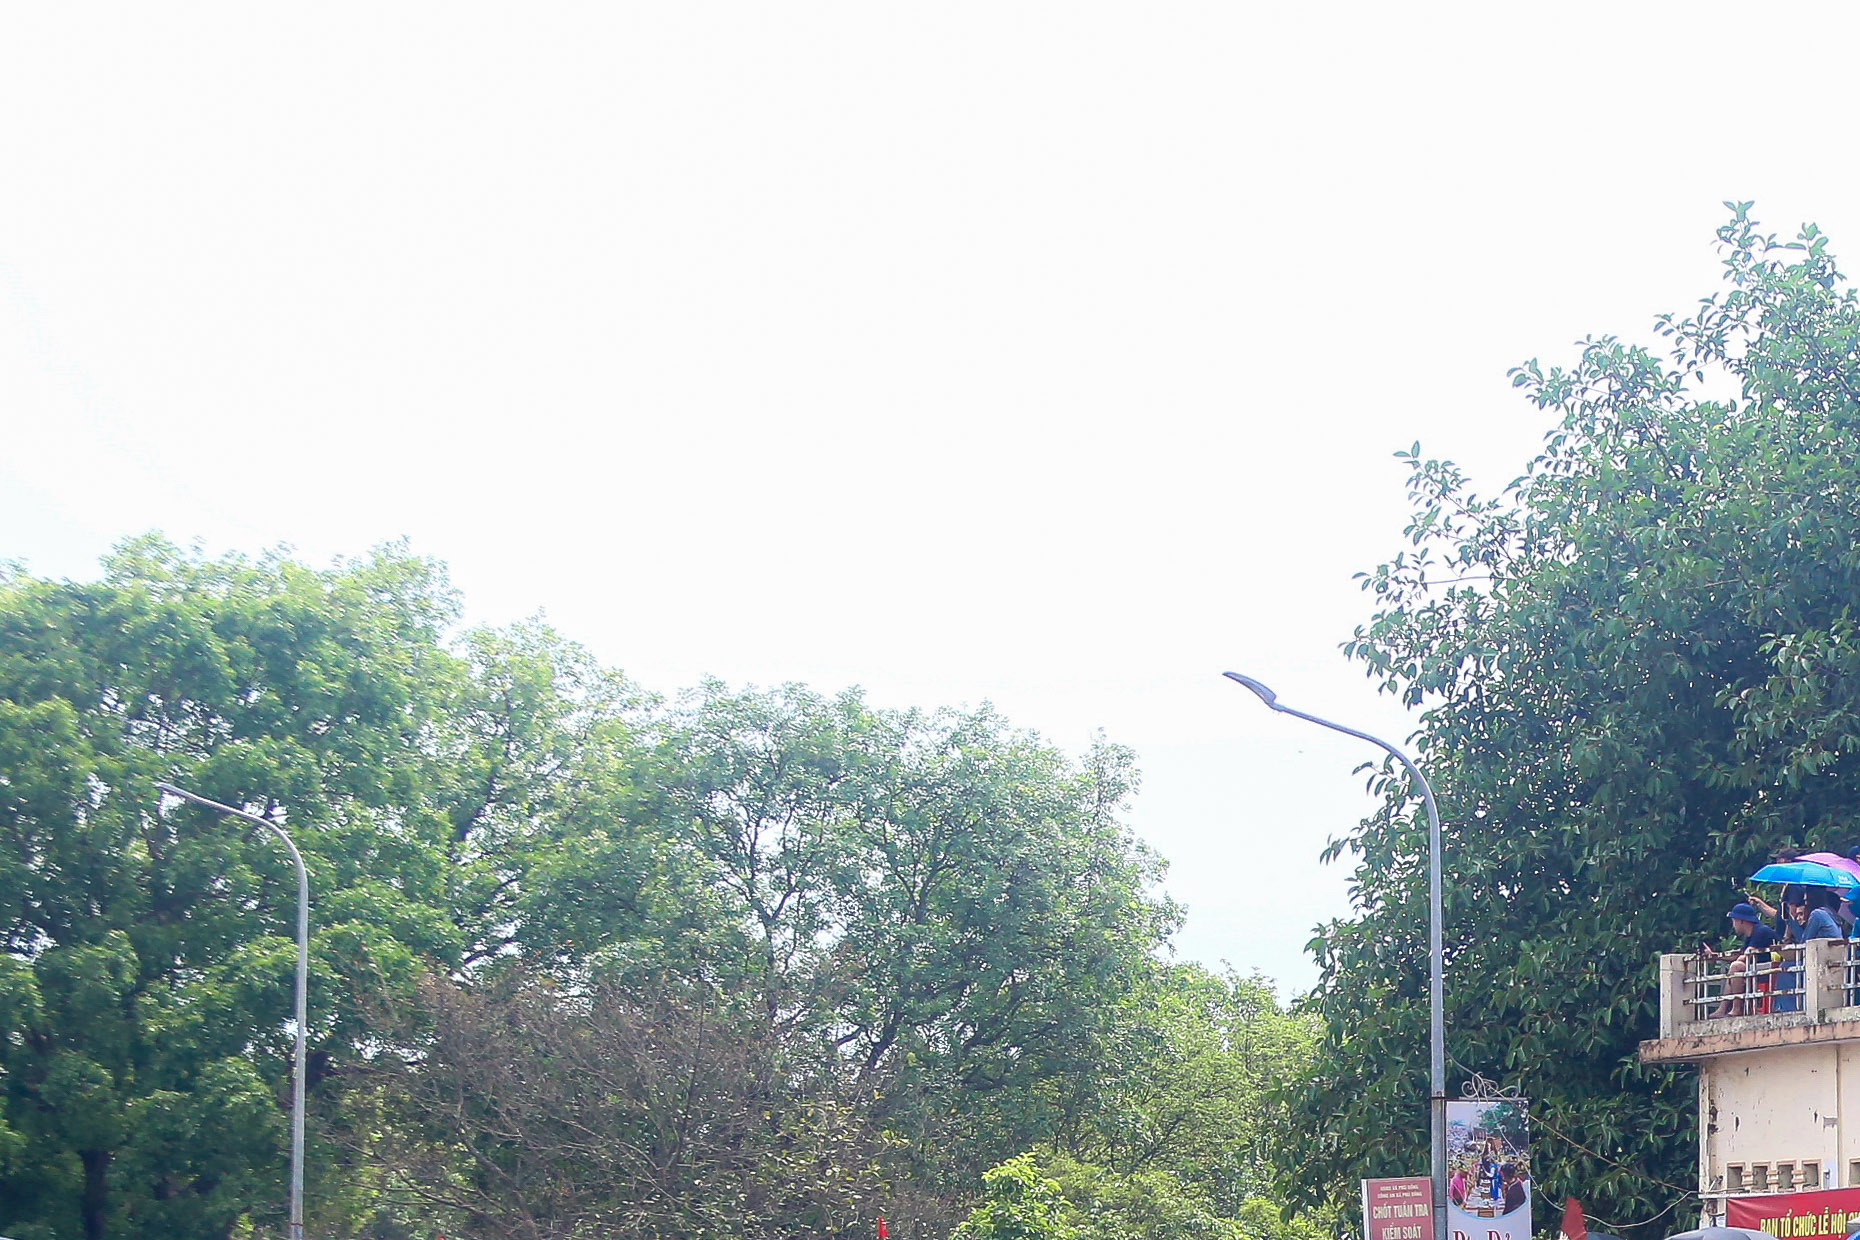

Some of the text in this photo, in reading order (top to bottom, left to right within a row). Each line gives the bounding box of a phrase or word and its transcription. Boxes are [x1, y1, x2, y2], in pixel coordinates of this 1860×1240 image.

[1373, 1201, 1392, 1219] CHỐT
[1414, 1203, 1429, 1217] TRA
[1402, 1223, 1422, 1239] SOÁT
[1760, 1219, 1778, 1237] BAN
[1780, 1208, 1792, 1238] TỔ
[1792, 1210, 1817, 1237] CHỨC
[1818, 1206, 1829, 1235] LỄ
[1830, 1210, 1846, 1239] HỘI
